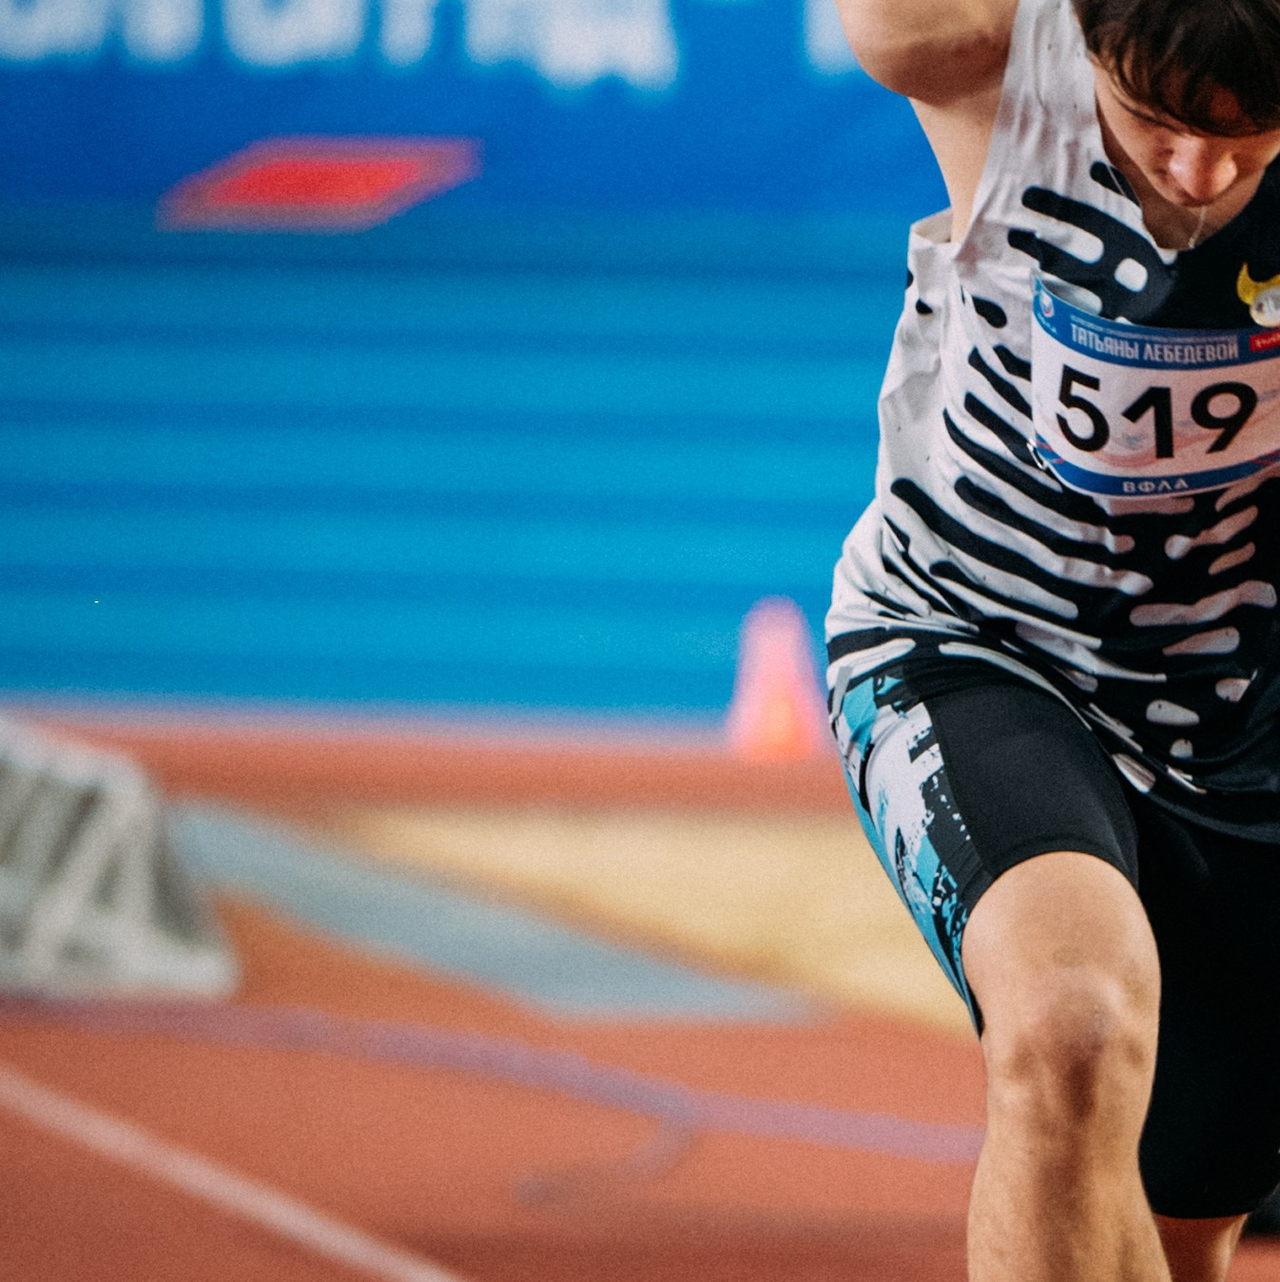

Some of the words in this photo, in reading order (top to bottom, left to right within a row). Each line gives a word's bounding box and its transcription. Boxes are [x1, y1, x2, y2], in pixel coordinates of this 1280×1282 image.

[1069, 322, 1140, 361] ТАТЬЯНЫ
[1143, 337, 1240, 365] ЛЕБЕДЕВОЙ
[1055, 364, 1259, 459] 519
[1122, 478, 1190, 494] ВФЛА
